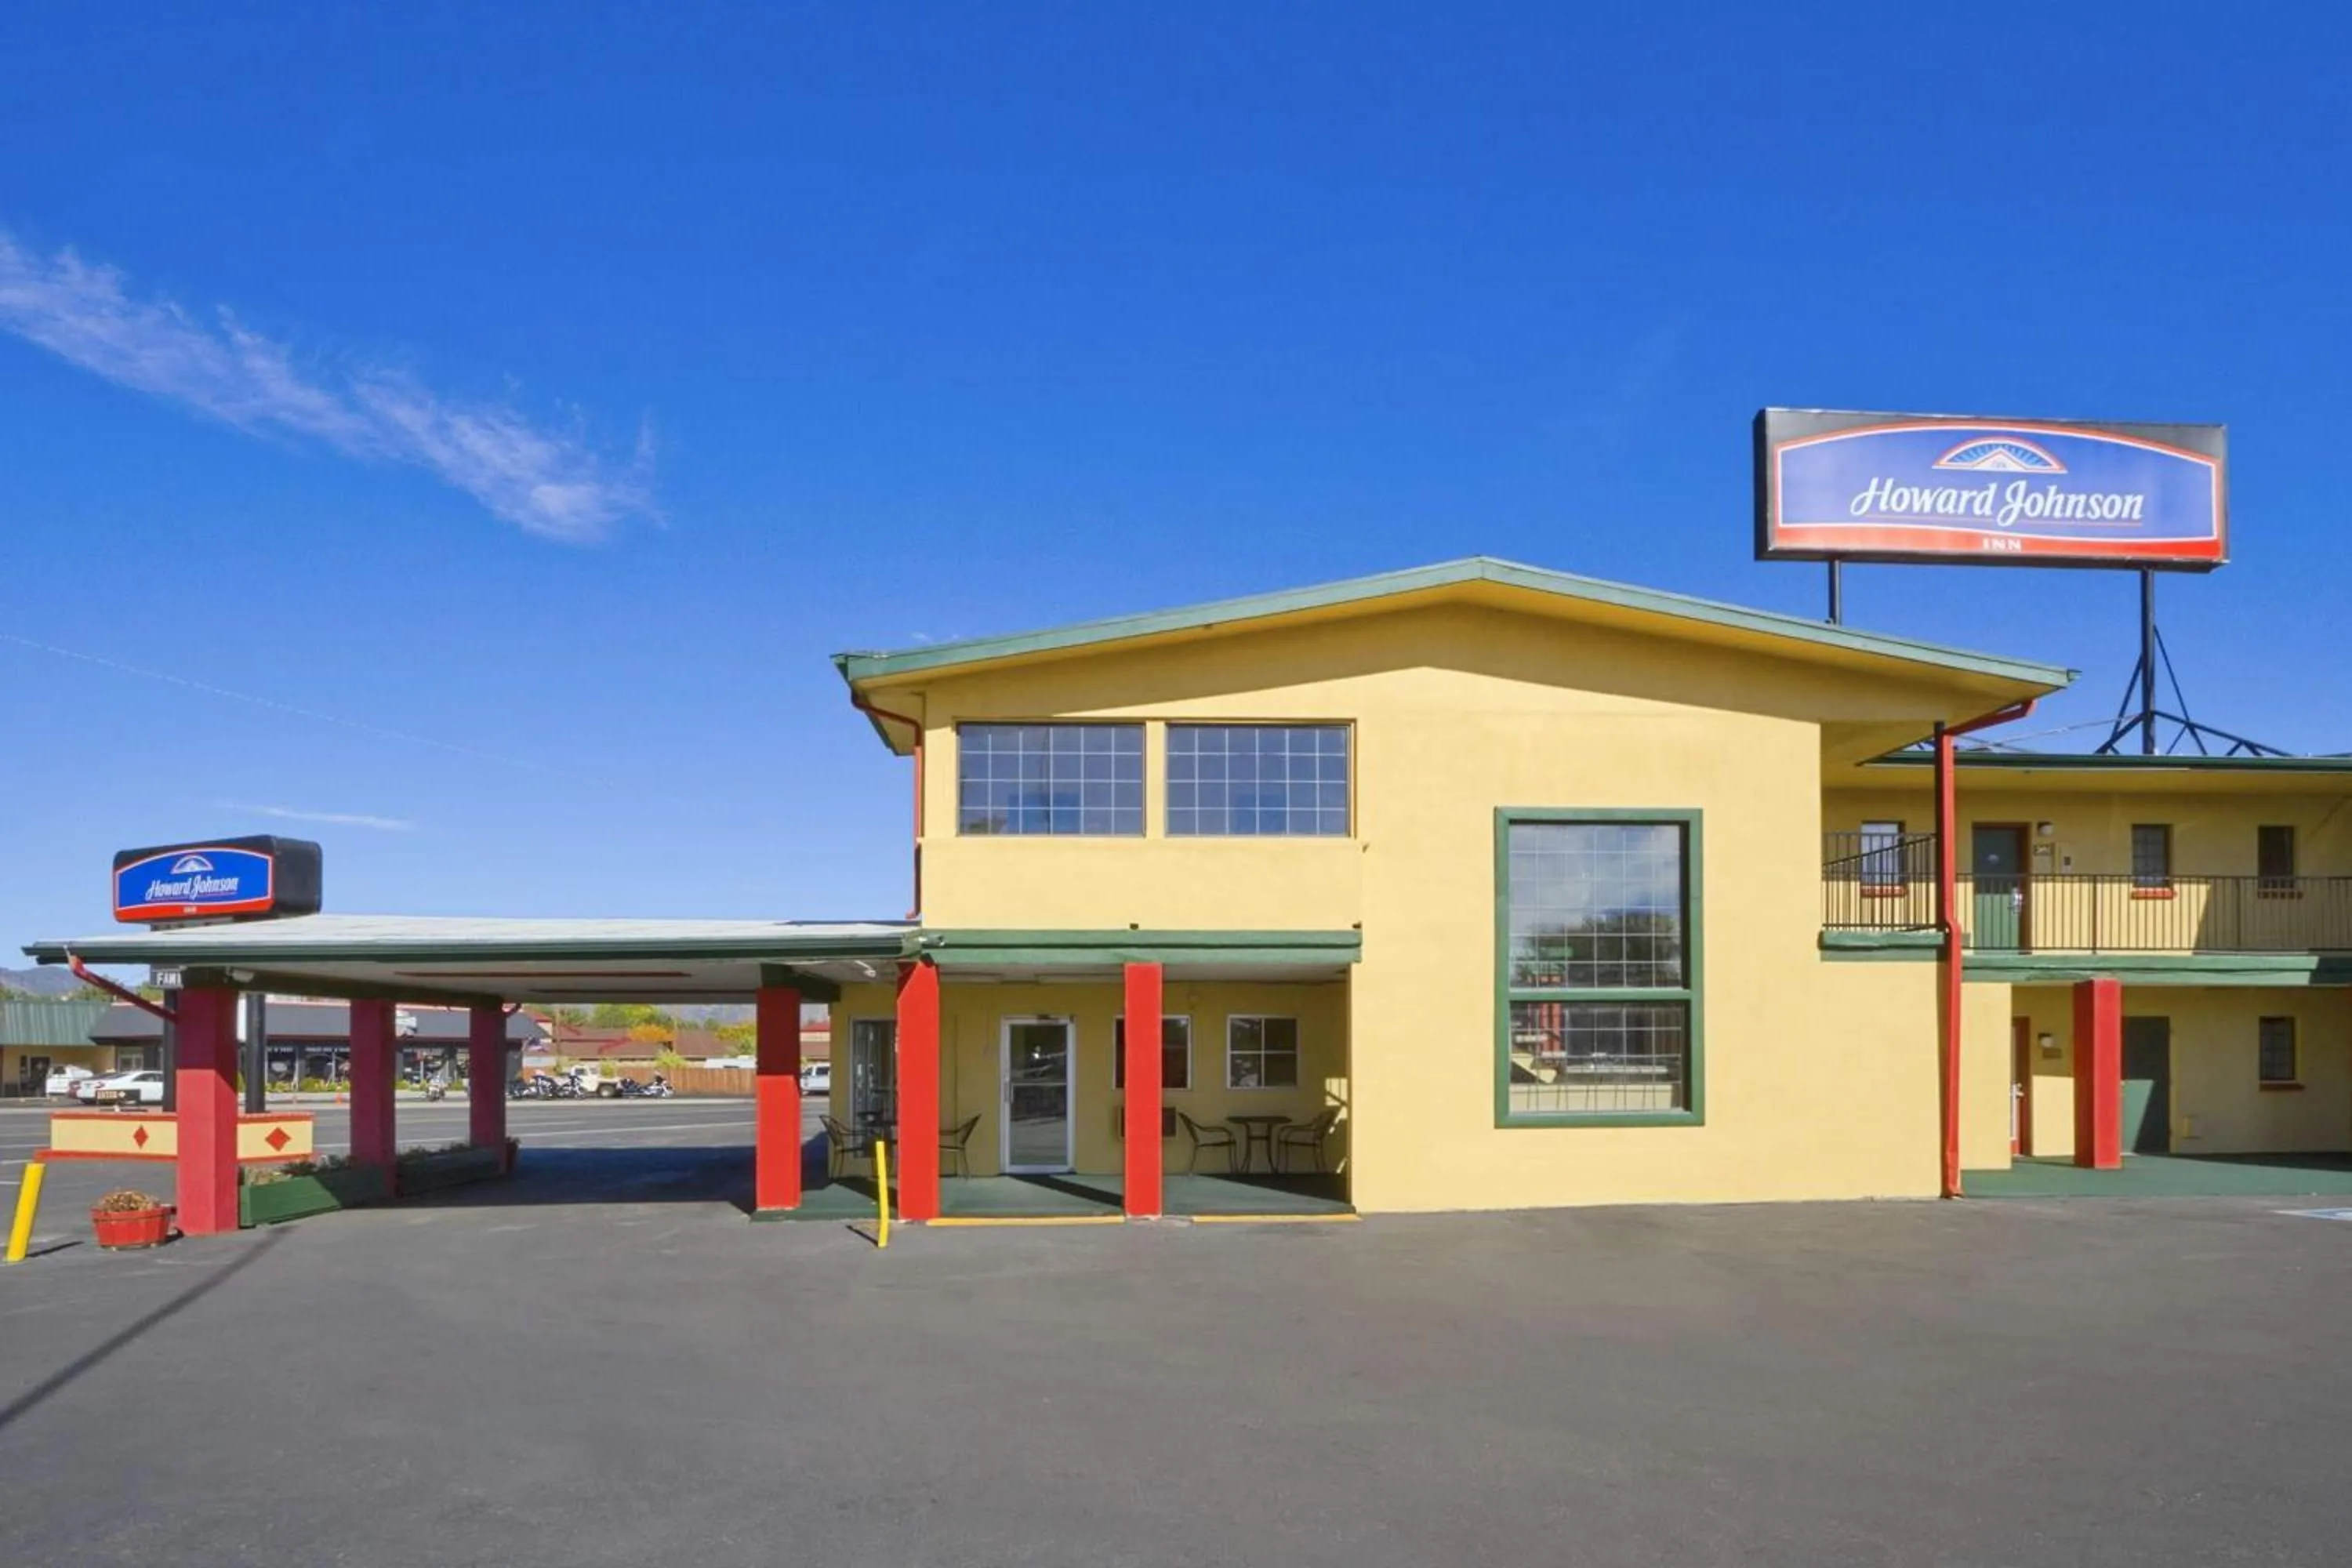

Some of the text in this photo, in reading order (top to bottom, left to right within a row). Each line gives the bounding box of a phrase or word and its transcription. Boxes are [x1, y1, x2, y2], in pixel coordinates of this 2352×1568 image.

[1850, 477, 2144, 526] Howard Johnson
[1983, 538, 2022, 551] INN
[145, 875, 238, 901] Howard Johnson
